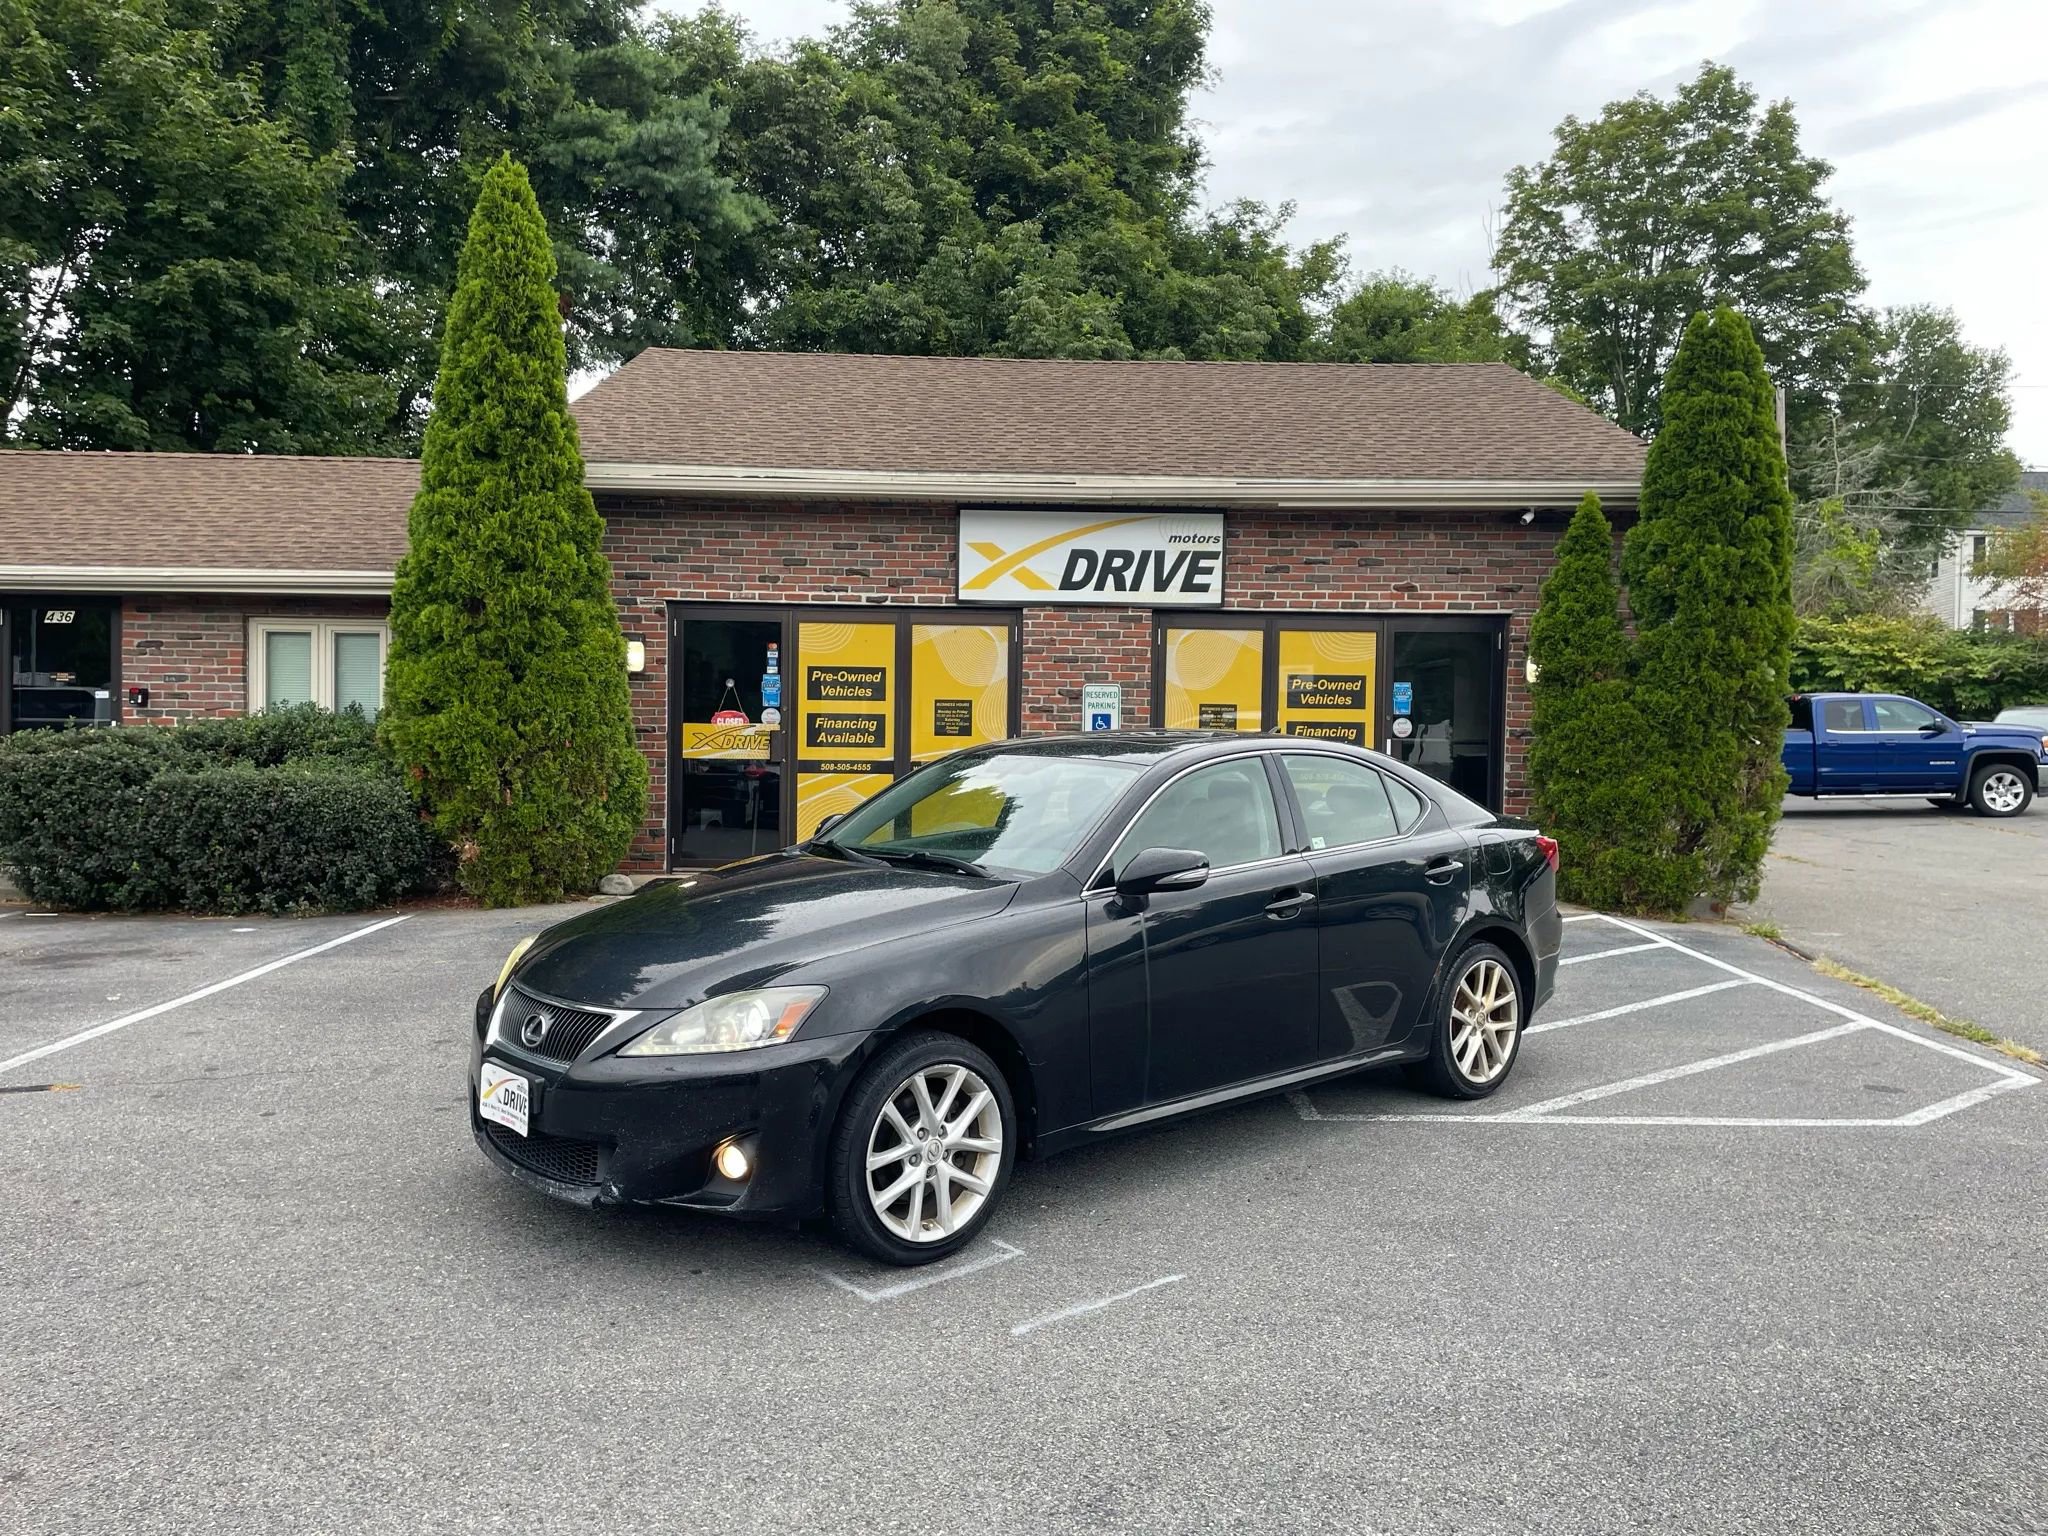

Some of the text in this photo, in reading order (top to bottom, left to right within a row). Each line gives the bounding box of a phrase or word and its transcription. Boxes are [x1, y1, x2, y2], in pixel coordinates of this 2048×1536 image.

[1168, 533, 1221, 544] motors
[1058, 548, 1221, 593] DRIVE
[46, 611, 73, 622] 436
[811, 670, 881, 682] Pre-Owned
[1291, 678, 1361, 690] Pre-Owned
[820, 685, 873, 697] Vehicles
[1086, 691, 1118, 699] RESERVED
[1300, 693, 1353, 705] Vehicles
[1087, 701, 1116, 710] PARKING
[716, 717, 744, 725] CLOSED
[815, 717, 877, 731] Financing
[816, 732, 875, 744] Available
[1295, 725, 1357, 739] Financing
[820, 763, 871, 771] 508-505-4555
[503, 1087, 527, 1116] DRIVE
